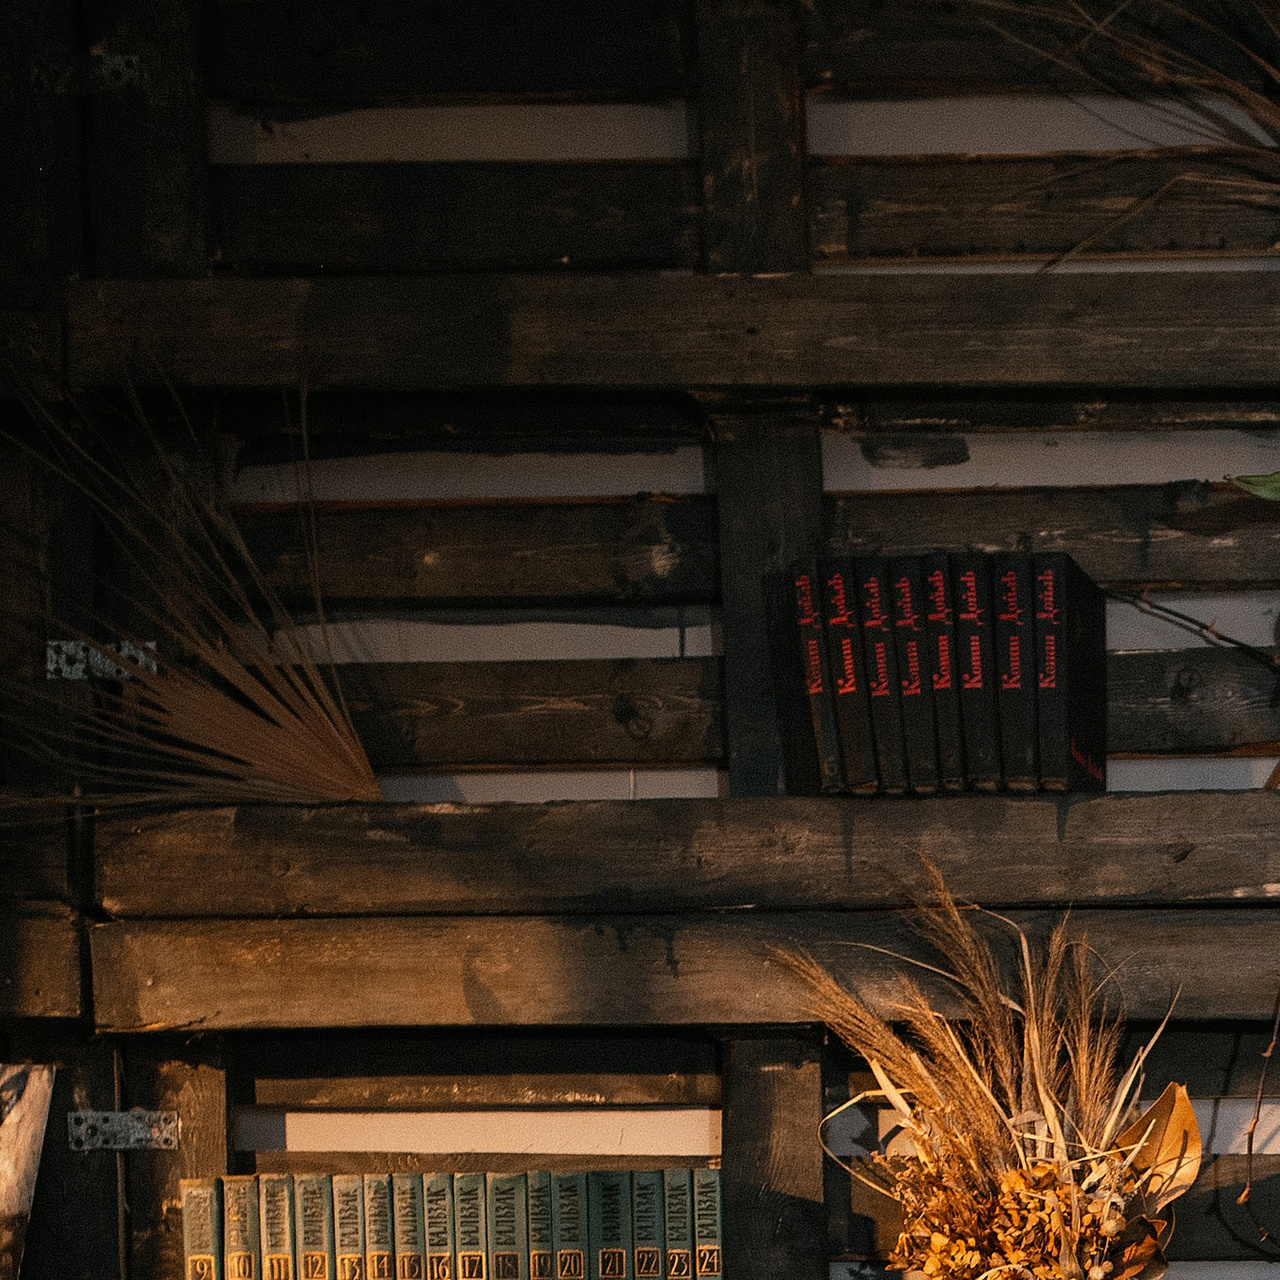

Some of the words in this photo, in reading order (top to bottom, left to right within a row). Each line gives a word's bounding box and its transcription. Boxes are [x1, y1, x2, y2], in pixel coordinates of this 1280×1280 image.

[339, 1189, 358, 1248] БАЛЬЗАК
[428, 1187, 449, 1247] БАЛЬЗАК
[460, 1188, 481, 1246] БАЛЬЗАК
[493, 1187, 515, 1245] БАЛЬЗАК
[668, 1183, 687, 1241] БАЛЬЗАК
[697, 1180, 718, 1239] БАЛЬЗАК
[196, 1259, 207, 1280] 9
[233, 1256, 250, 1278] 10
[270, 1258, 284, 1280] 11
[307, 1256, 324, 1279] 12
[343, 1258, 359, 1280] 13
[372, 1255, 387, 1279] 14
[403, 1256, 419, 1279] 15
[432, 1256, 449, 1280] 16
[463, 1256, 480, 1278] 17
[498, 1256, 517, 1278] 18
[534, 1254, 551, 1277] 19
[561, 1254, 580, 1275] 20
[604, 1253, 619, 1275] 21
[639, 1251, 657, 1273] 22
[670, 1254, 687, 1277] 23
[701, 1250, 718, 1272] 24
